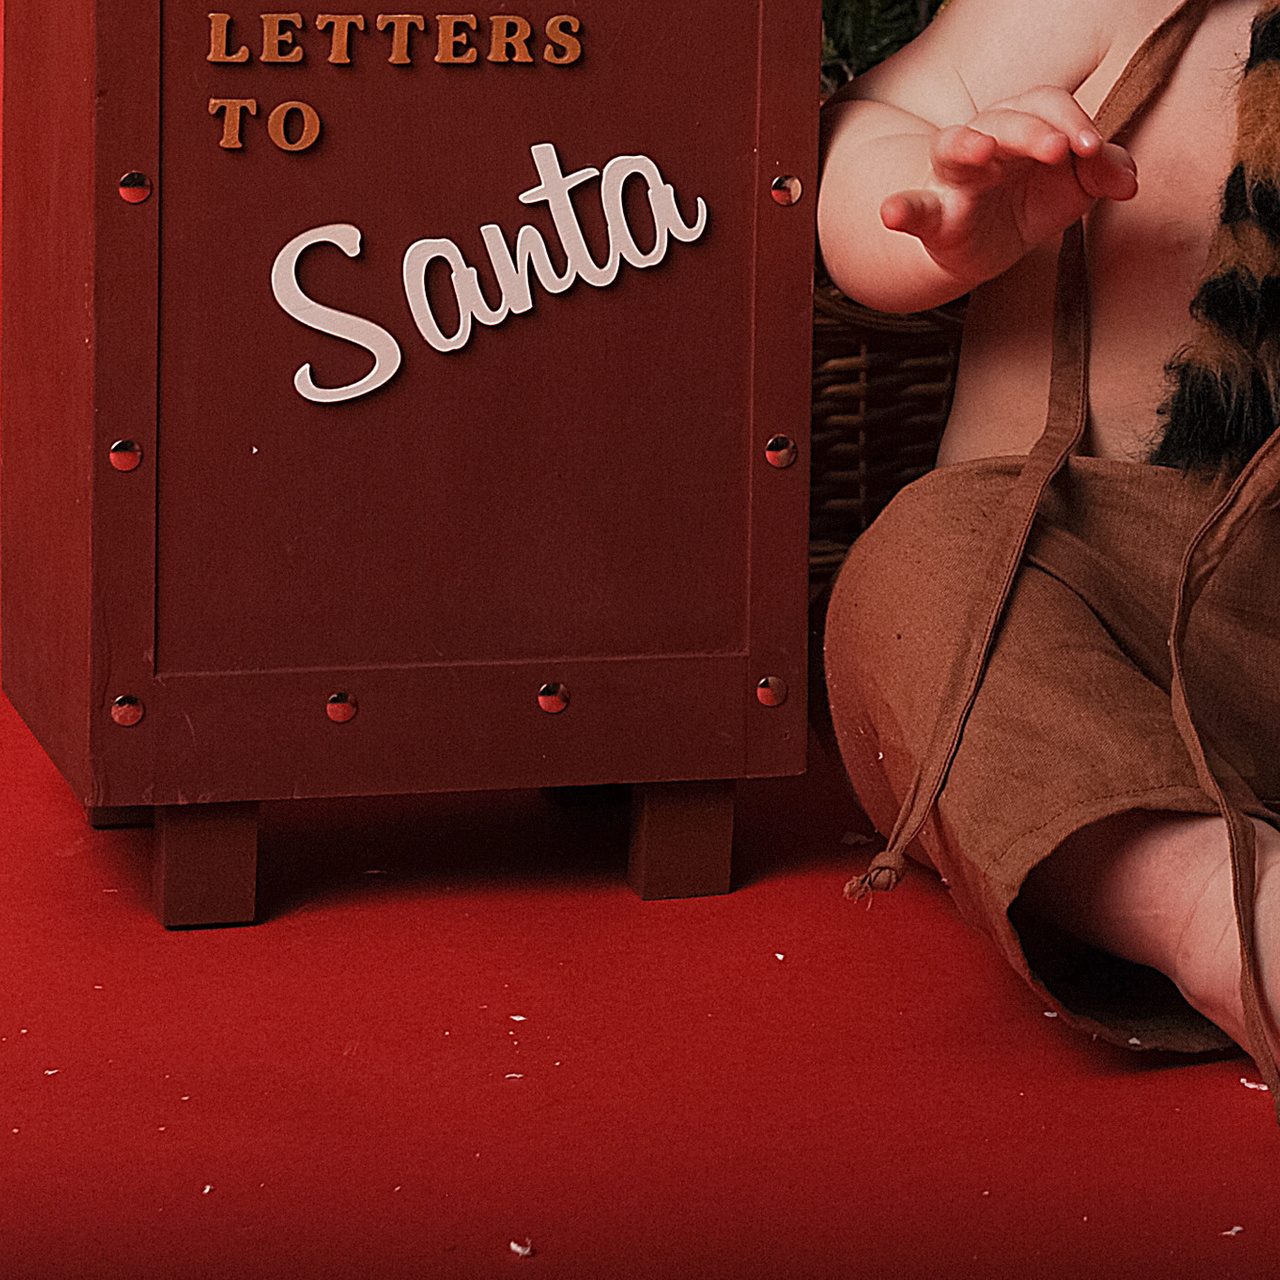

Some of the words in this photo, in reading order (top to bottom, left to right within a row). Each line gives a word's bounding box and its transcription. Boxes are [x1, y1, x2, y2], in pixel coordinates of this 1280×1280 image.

[206, 13, 582, 65] LETTERS
[208, 98, 321, 151] TO
[271, 143, 707, 403] Santa
